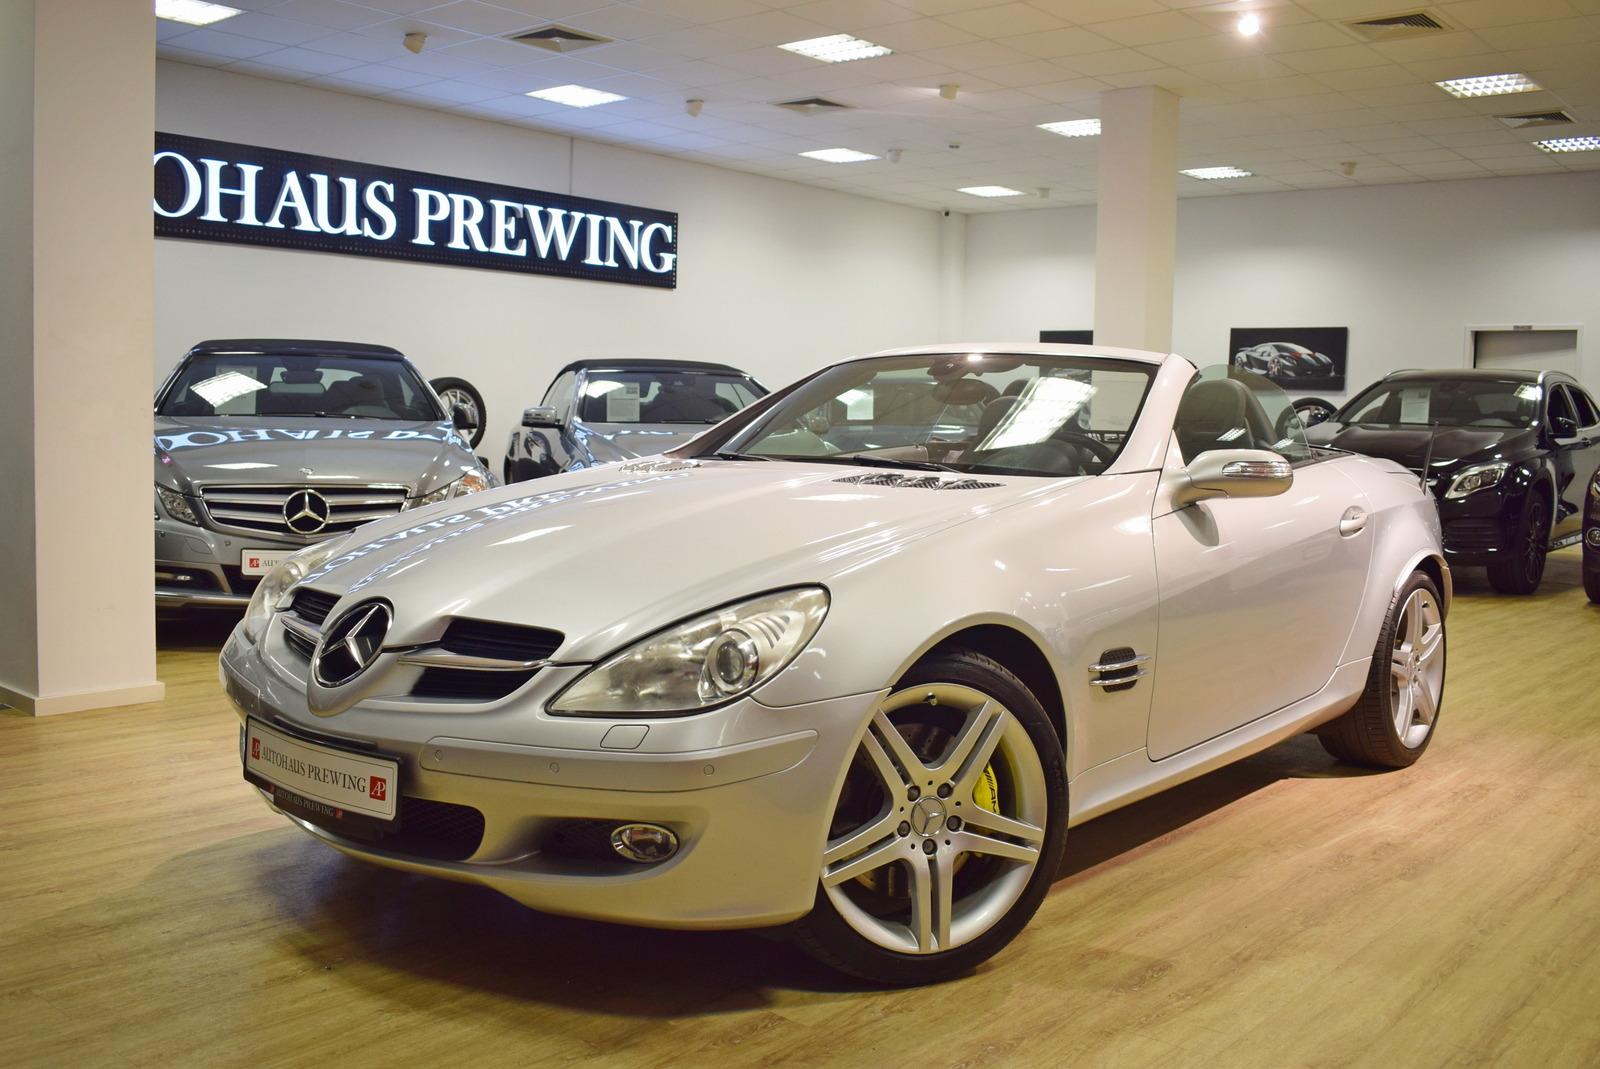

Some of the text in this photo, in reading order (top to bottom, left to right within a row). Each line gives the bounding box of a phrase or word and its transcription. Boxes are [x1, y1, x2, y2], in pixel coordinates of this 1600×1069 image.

[410, 187, 678, 273] PREWING
[262, 746, 306, 776] AUTOHAUS
[308, 763, 367, 794] PREWING
